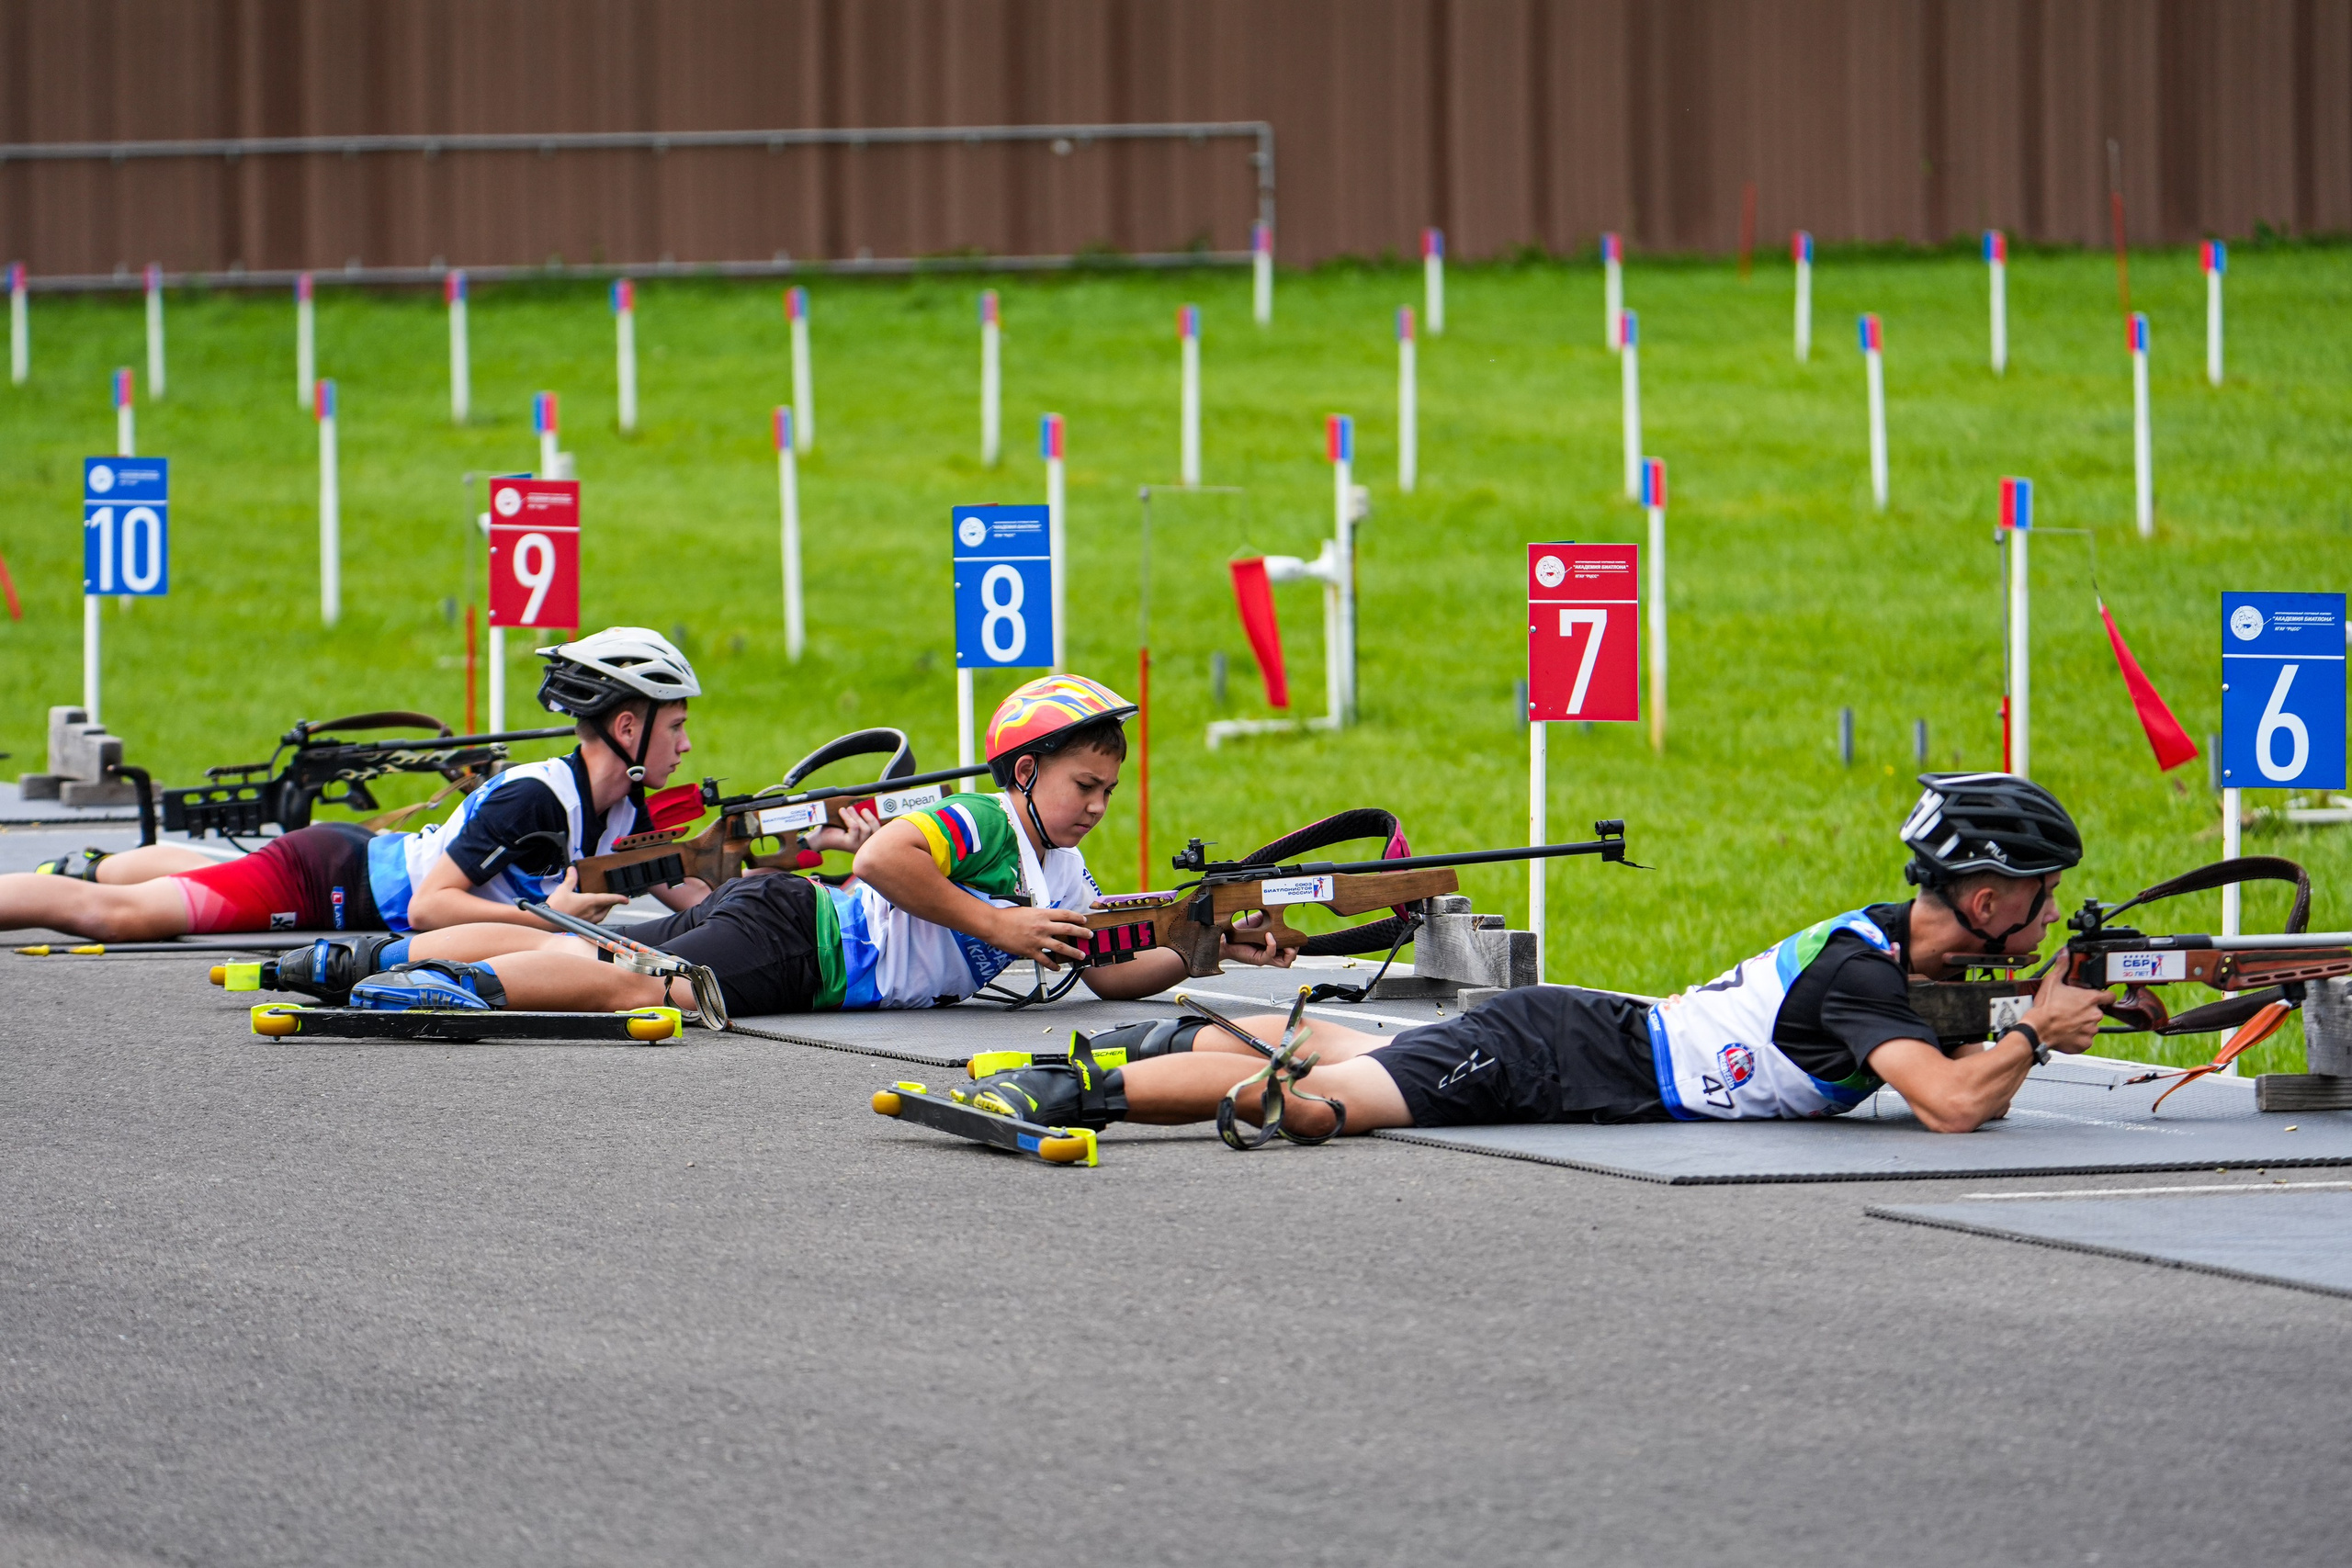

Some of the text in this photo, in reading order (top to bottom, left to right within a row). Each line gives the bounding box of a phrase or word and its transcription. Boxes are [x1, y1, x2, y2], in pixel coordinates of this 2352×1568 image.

[90, 506, 162, 592] 10
[513, 533, 556, 625] 9
[981, 564, 1026, 663] 8
[1559, 609, 1607, 714] 7
[2256, 664, 2310, 782] 6
[901, 795, 935, 809] Ареал
[1984, 840, 2007, 863] FILA
[2123, 959, 2150, 967] СБР
[1702, 1075, 1735, 1109] 47
